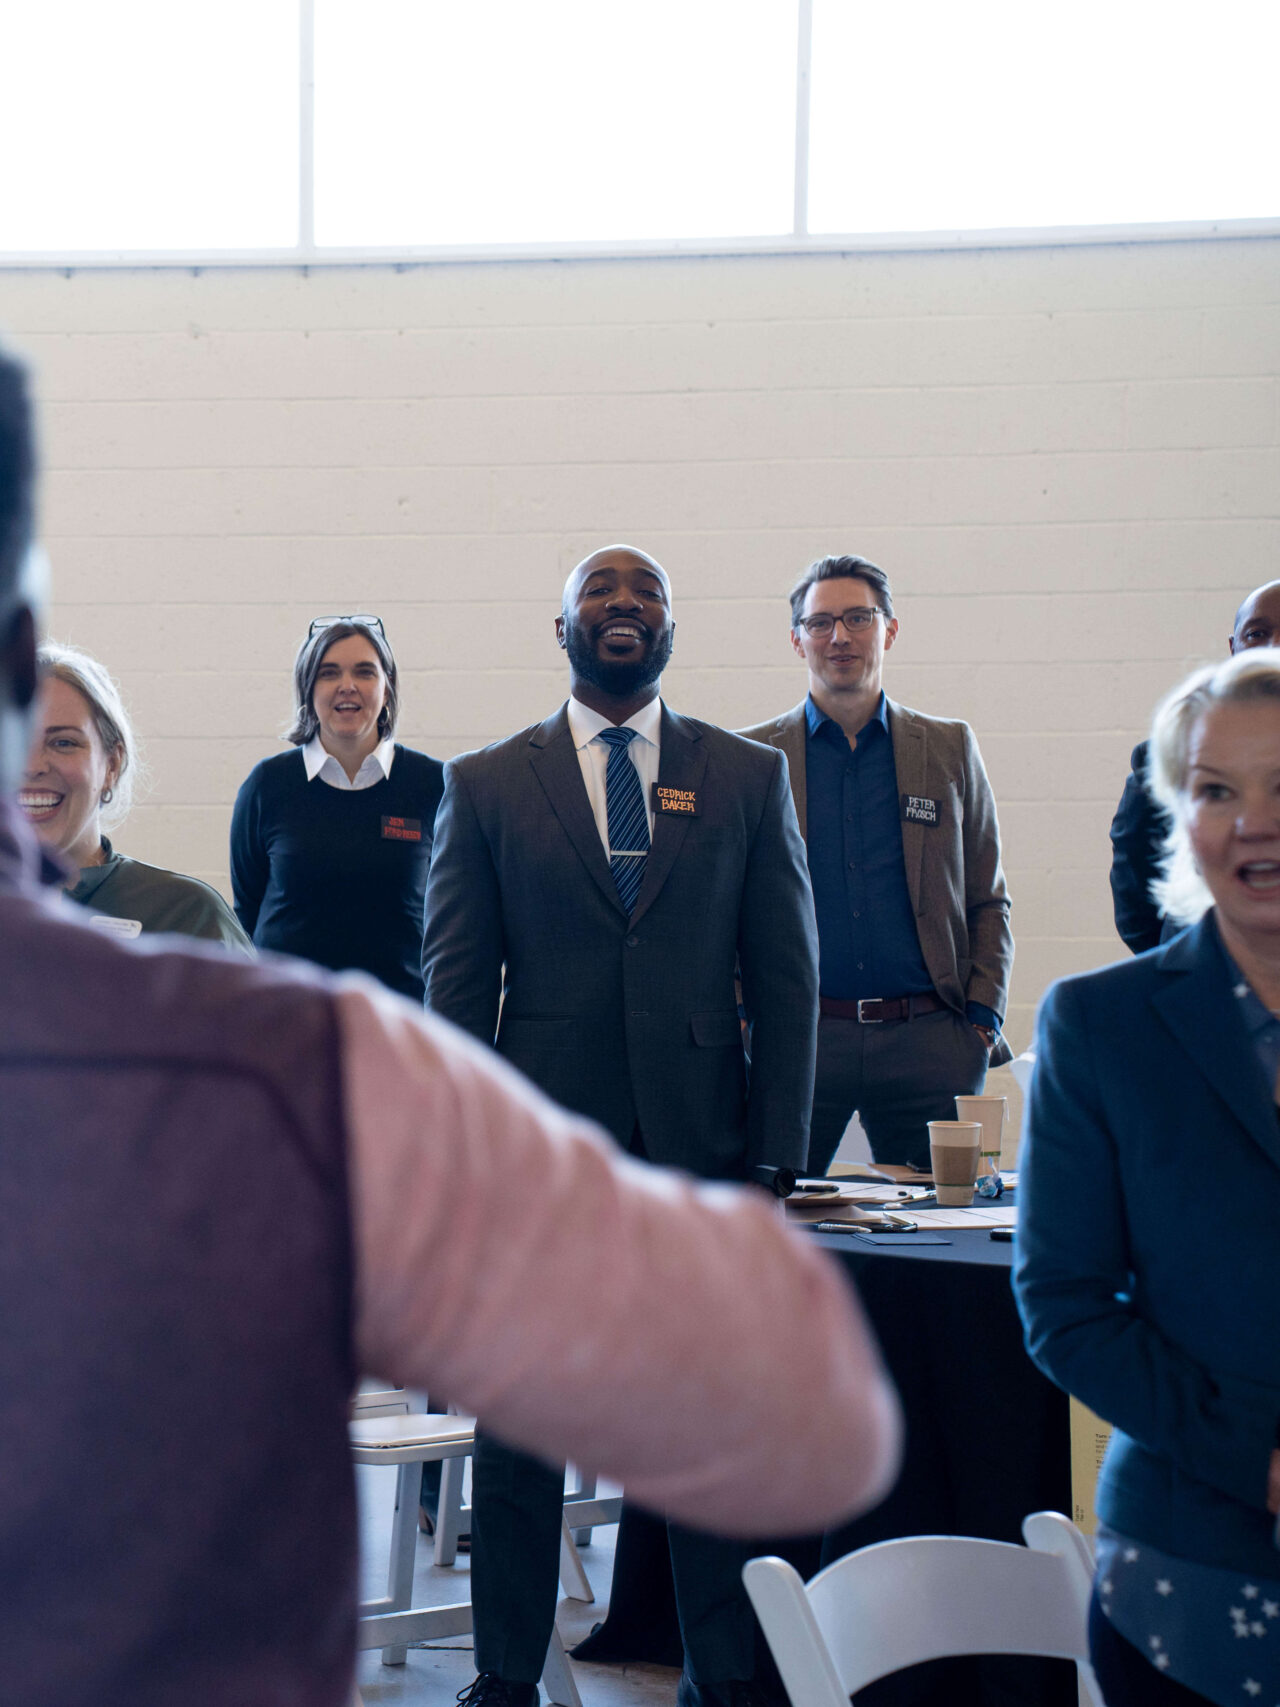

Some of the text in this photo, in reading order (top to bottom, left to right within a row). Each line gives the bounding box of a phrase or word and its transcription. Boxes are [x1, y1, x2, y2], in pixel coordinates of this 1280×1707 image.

[657, 787, 696, 801] CEDRICK
[661, 799, 695, 812] BAKER
[908, 796, 936, 811] PETER
